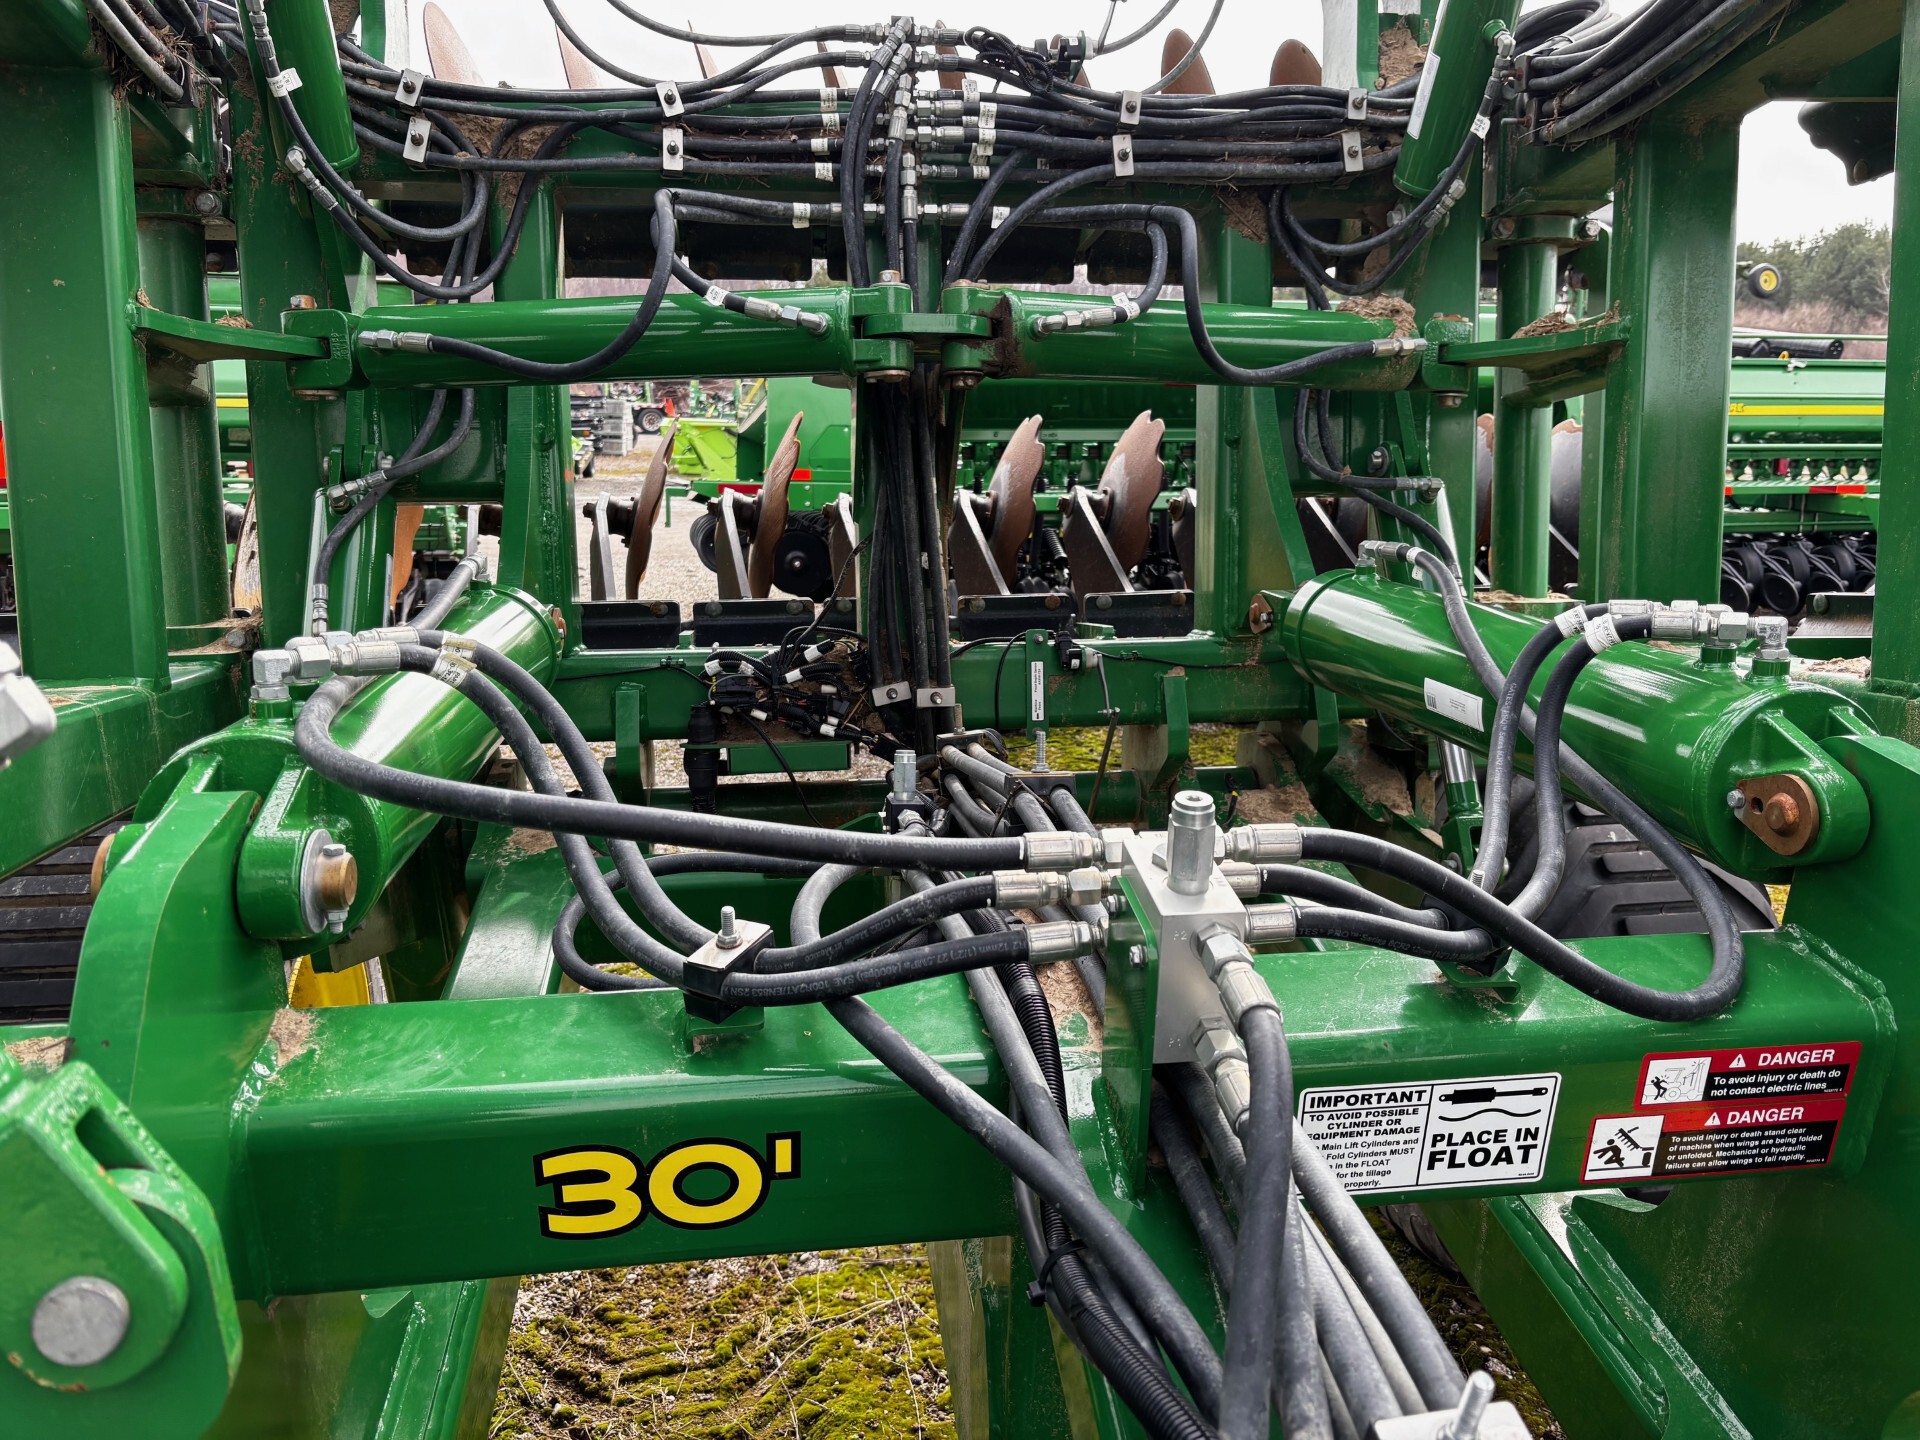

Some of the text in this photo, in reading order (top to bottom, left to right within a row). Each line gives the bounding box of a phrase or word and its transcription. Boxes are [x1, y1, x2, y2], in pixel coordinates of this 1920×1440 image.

[1758, 1049, 1835, 1066] DANGER
[1714, 1077, 1726, 1085] To
[1729, 1075, 1755, 1084] avoid
[1757, 1073, 1785, 1085] injury
[1800, 1071, 1826, 1079] death
[1829, 1069, 1841, 1077] do
[1711, 1088, 1727, 1096] not
[1729, 1086, 1765, 1095] contact
[1767, 1083, 1802, 1093] electric
[1310, 1090, 1427, 1108] IMPORTANT
[1327, 1112, 1361, 1120] AVOID
[1365, 1108, 1419, 1118] POSSIBLE
[1727, 1107, 1804, 1125] DANGER
[1328, 1120, 1383, 1130] CYLINDER
[1374, 1127, 1420, 1137] DAMAGE
[1431, 1127, 1539, 1148] PLACE IN
[1683, 1134, 1704, 1142] avoid
[1706, 1133, 1728, 1142] injury
[1322, 1143, 1342, 1151] Main
[1345, 1141, 1358, 1149] Lift
[1361, 1140, 1400, 1148] Cylinders
[1736, 1140, 1759, 1148] wings
[1348, 1150, 1387, 1159] Cylinders
[1390, 1148, 1415, 1156] MUST
[1427, 1144, 1538, 1170] FLOAT
[1678, 1152, 1714, 1160] unfolded.
[1716, 1149, 1759, 1157] Mechanical
[1771, 1145, 1806, 1154] hydraulic
[1361, 1159, 1391, 1167] FLOAT
[1666, 1162, 1690, 1170] failure
[1730, 1157, 1753, 1165] wings
[1366, 1169, 1391, 1177] tillage
[537, 1134, 797, 1237] 30'
[1344, 1180, 1381, 1188] properly.
